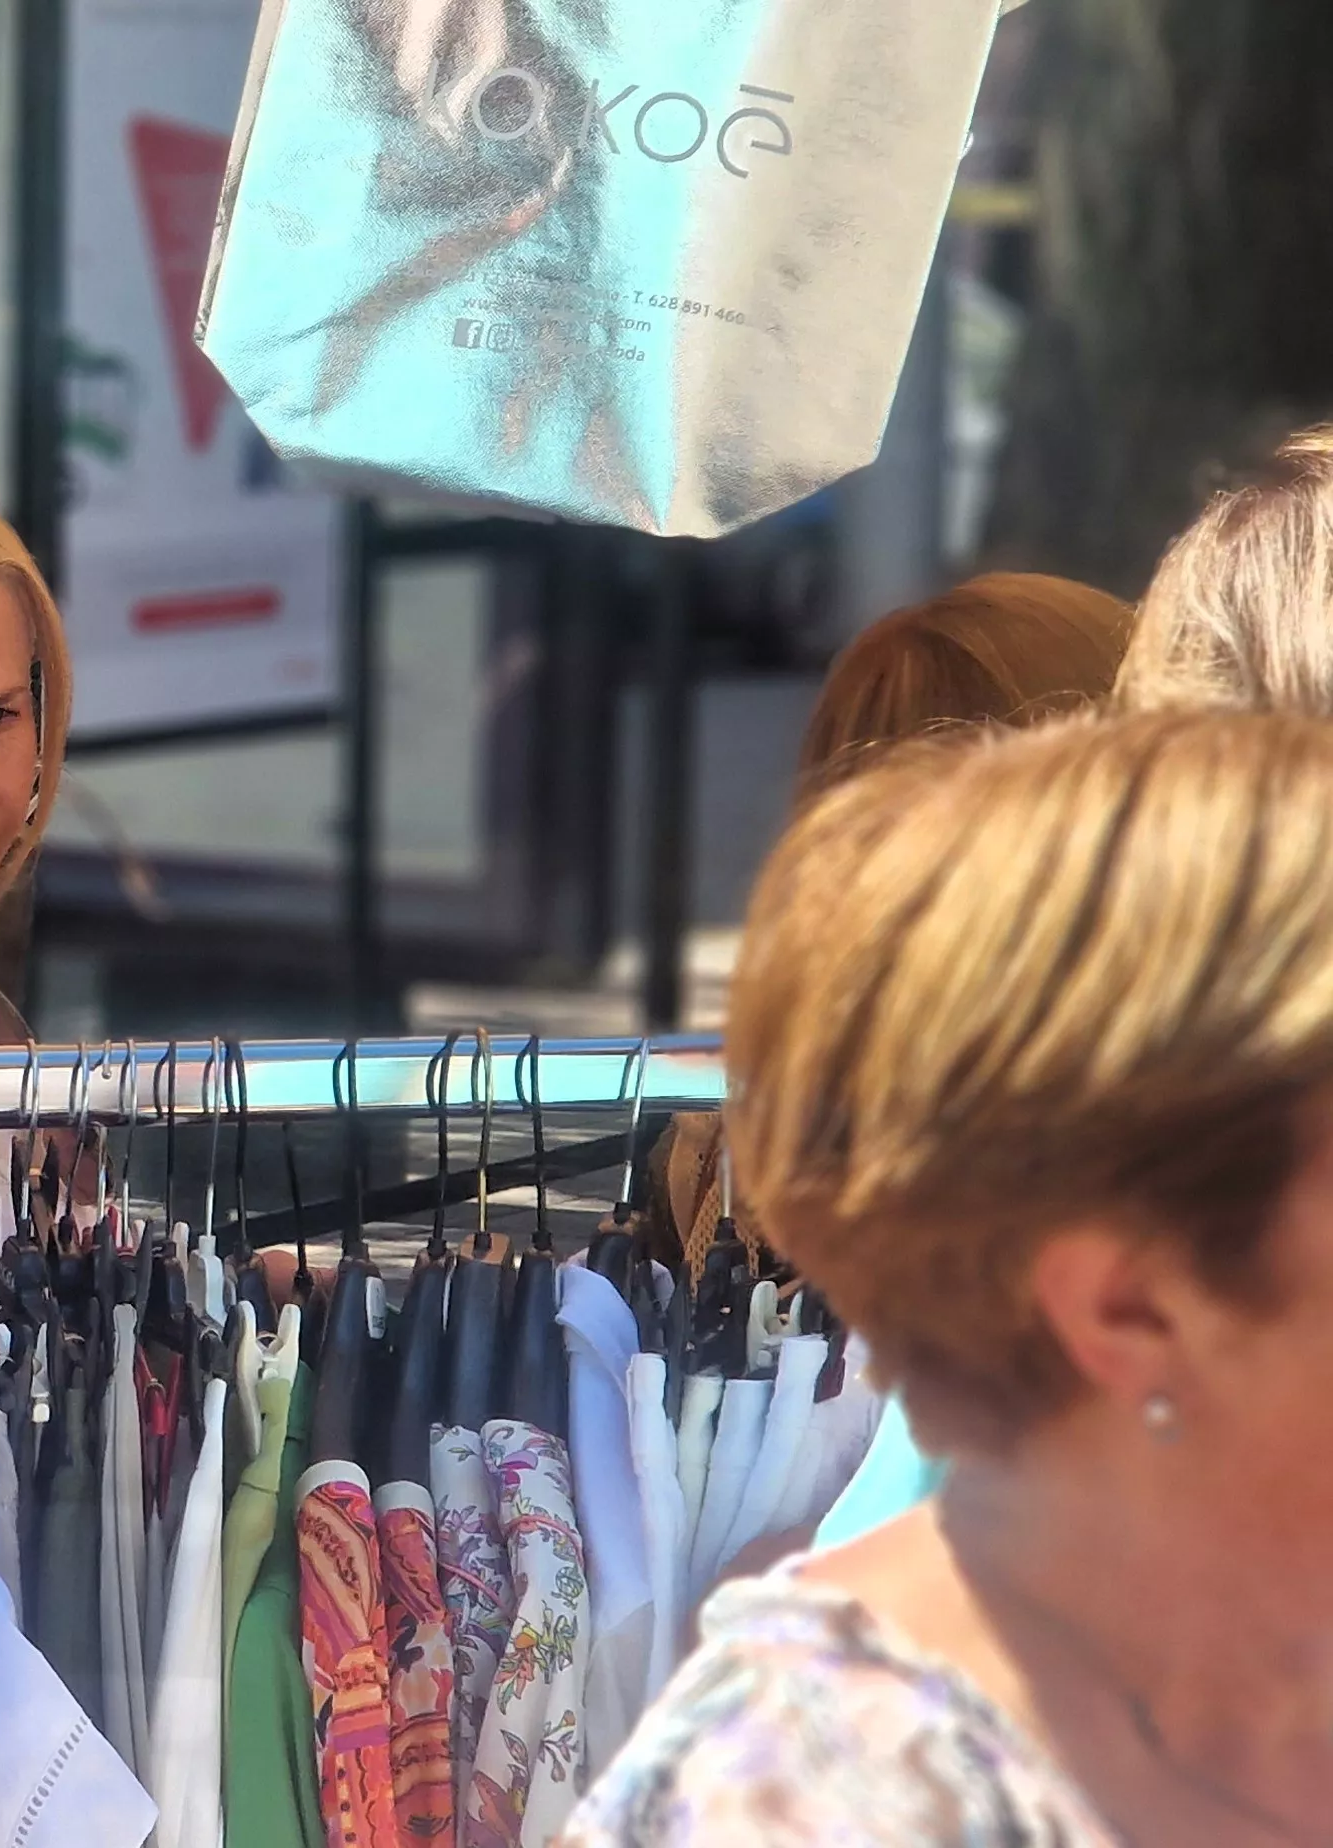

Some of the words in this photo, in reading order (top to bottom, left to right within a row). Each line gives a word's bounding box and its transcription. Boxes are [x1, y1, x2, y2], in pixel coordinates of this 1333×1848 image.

[648, 293, 679, 311] 628
[682, 299, 711, 318] 891
[714, 307, 747, 326] 460
